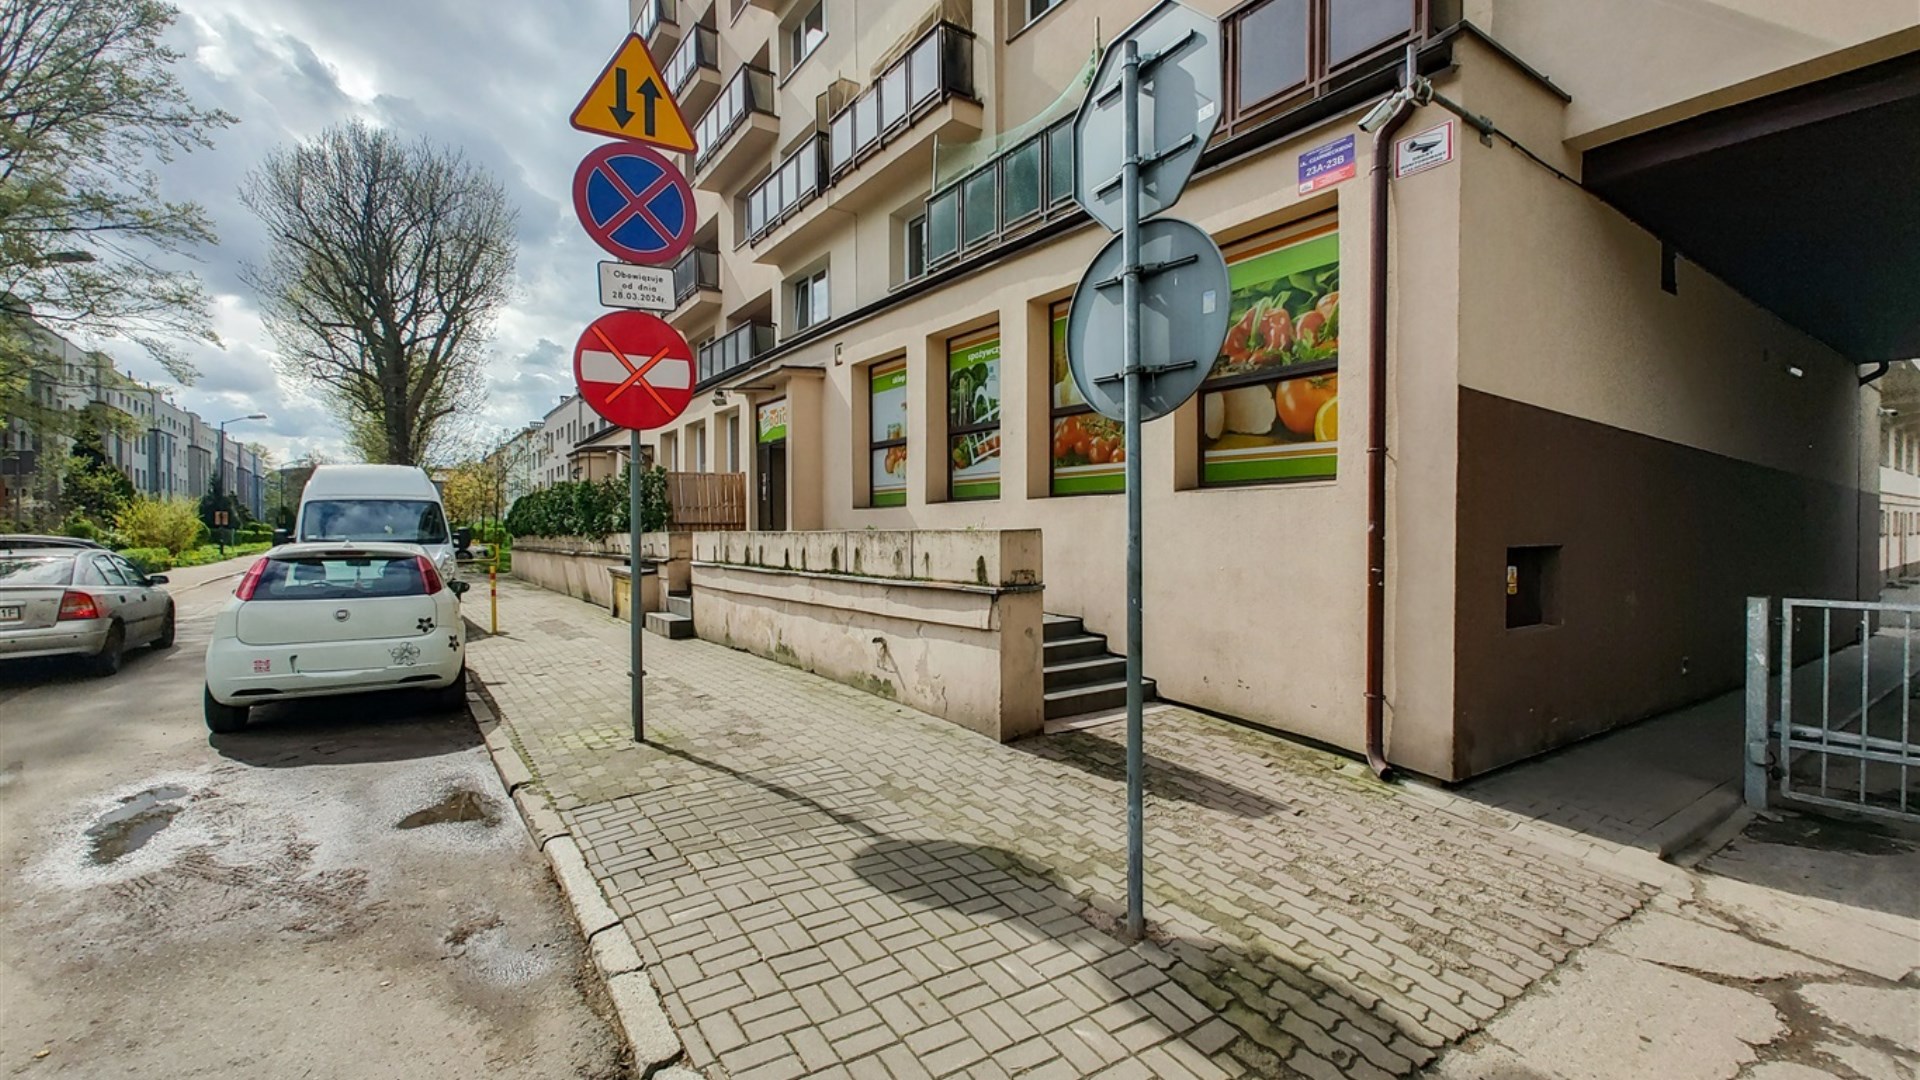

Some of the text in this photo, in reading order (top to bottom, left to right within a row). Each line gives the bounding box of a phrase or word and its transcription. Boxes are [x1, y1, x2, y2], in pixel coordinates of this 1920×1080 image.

[613, 270, 664, 284] Obowiązuje
[637, 283, 657, 292] dnia
[612, 291, 667, 304] 28.03.2024r.
